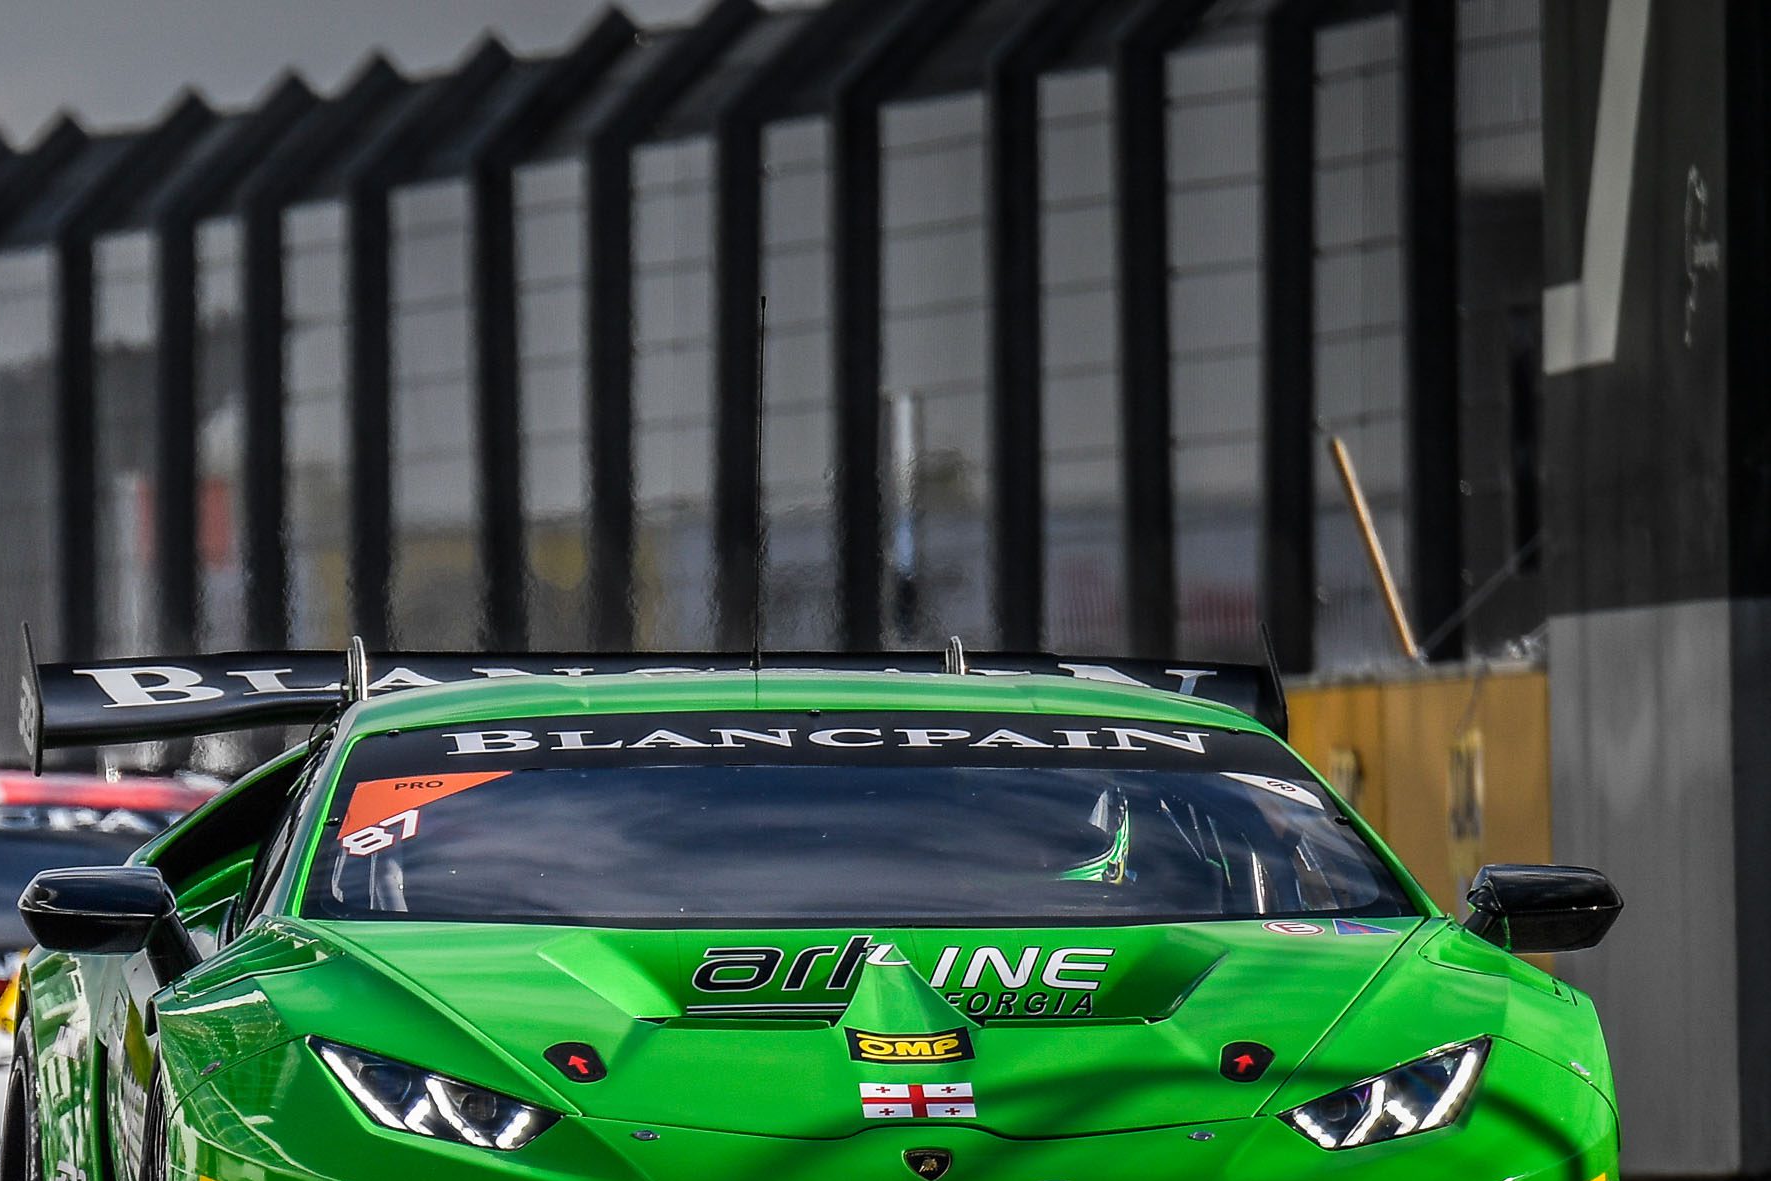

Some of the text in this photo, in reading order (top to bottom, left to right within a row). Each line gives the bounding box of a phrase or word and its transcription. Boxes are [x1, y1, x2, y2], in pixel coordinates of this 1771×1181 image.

[441, 727, 1210, 755] BLANCPAIN
[394, 780, 444, 790] PRO
[342, 808, 420, 856] 87
[944, 991, 1094, 1016] EORGIA
[858, 1037, 962, 1056] OMP
